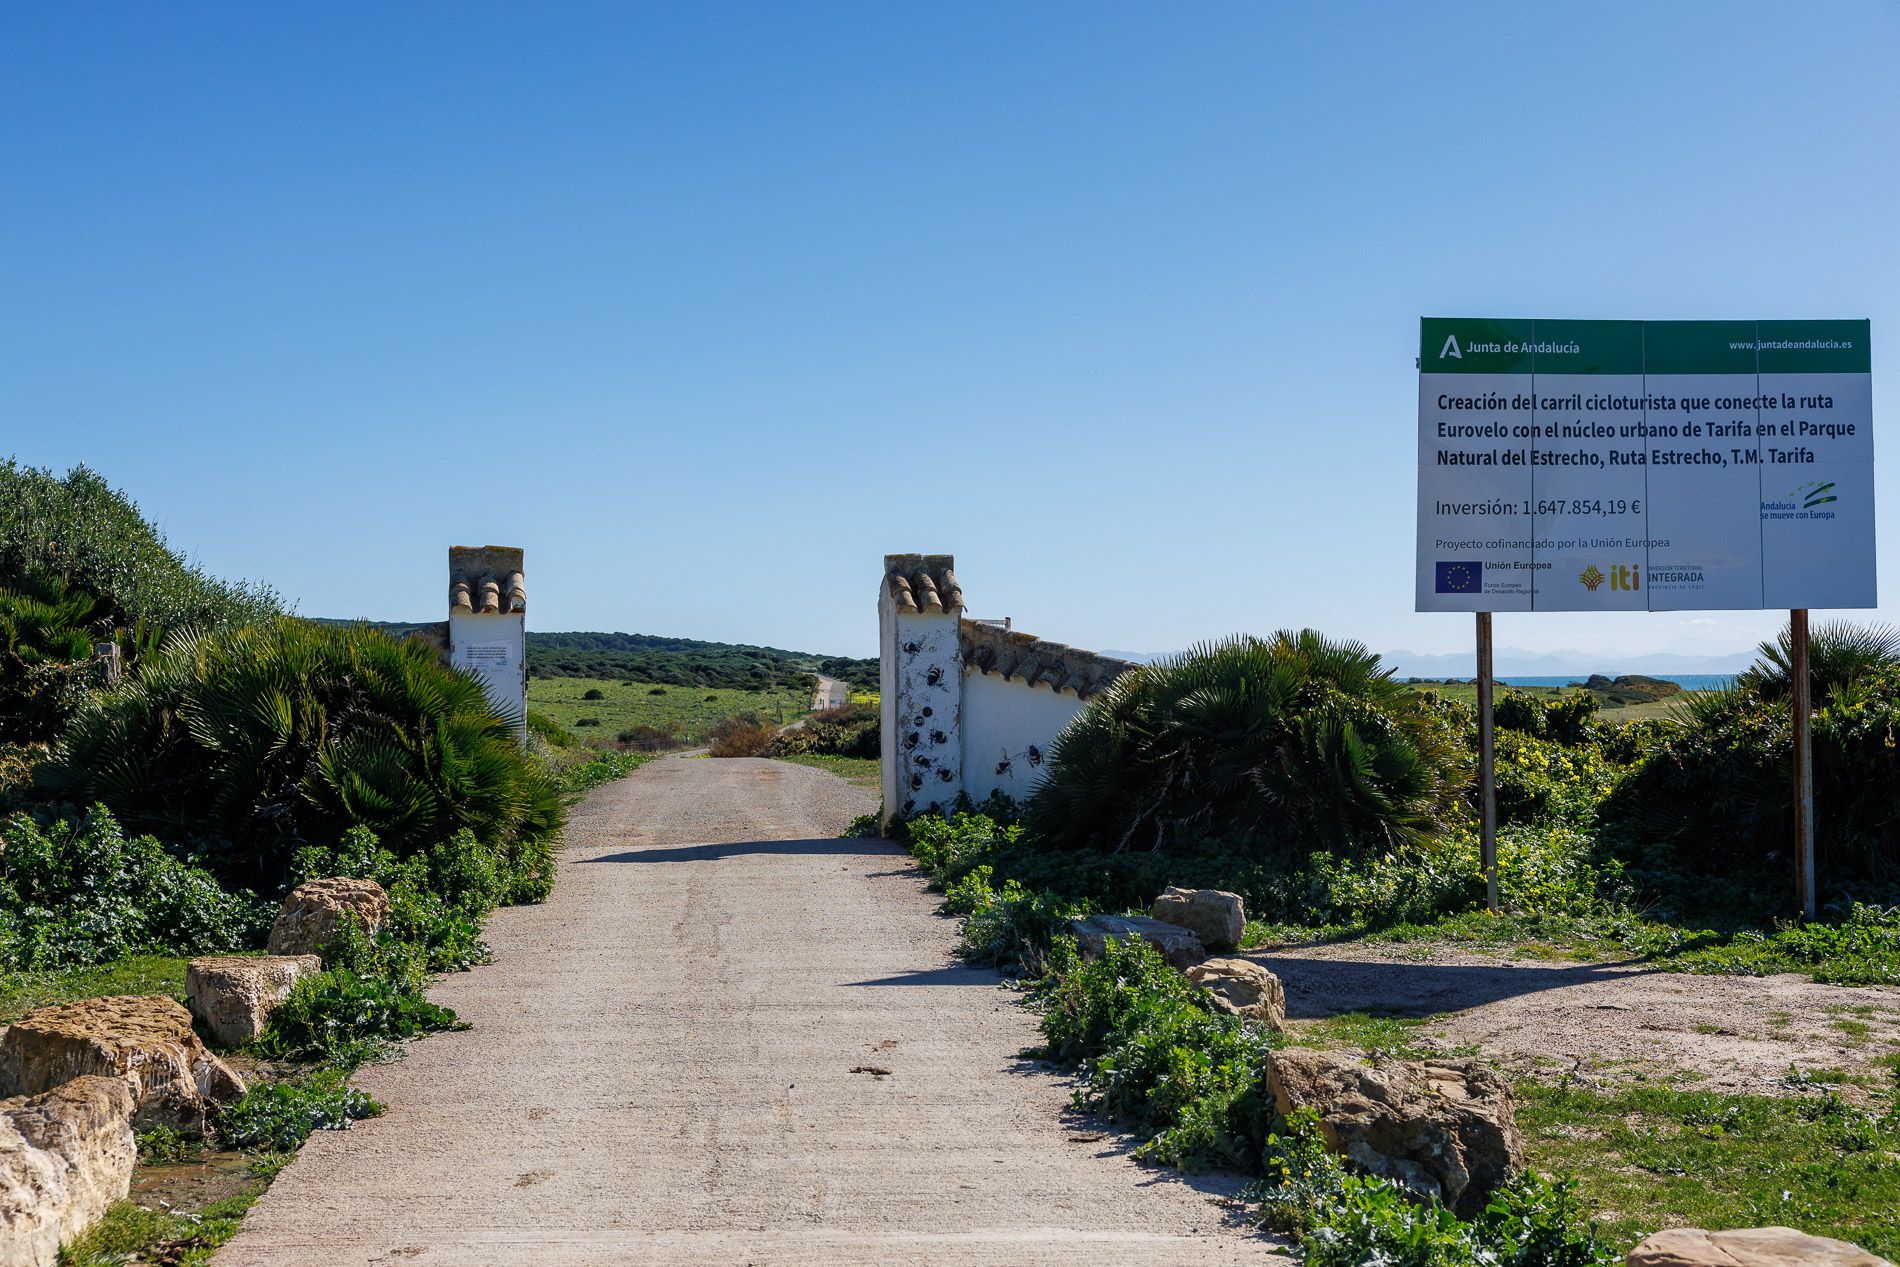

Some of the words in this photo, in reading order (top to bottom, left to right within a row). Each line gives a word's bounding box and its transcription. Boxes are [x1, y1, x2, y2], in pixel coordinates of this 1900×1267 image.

[1467, 342, 1500, 353] Junta
[1504, 342, 1518, 353] de
[1521, 341, 1580, 354] Andalucía
[1730, 340, 1852, 350] www.juntadeandalucia.es
[1438, 392, 1507, 410] Creación
[1512, 394, 1537, 410] del
[1541, 394, 1581, 410] carril
[1585, 394, 1676, 411] cicloturista
[1681, 397, 1710, 413] que
[1715, 396, 1777, 409] conecte
[1782, 393, 1795, 409] la
[1801, 395, 1833, 408] ruta
[1438, 422, 1508, 438] Eurovelo
[1513, 425, 1541, 438] con
[1545, 422, 1559, 438] el
[1563, 419, 1615, 438] núcleo
[1620, 422, 1678, 438] urbano
[1683, 422, 1701, 437] de
[1706, 421, 1751, 437] Tarifa
[1756, 425, 1776, 436] en
[1781, 421, 1795, 436] el
[1800, 421, 1855, 439] Parque
[1438, 450, 1497, 465] Natural
[1502, 450, 1525, 465] del
[1531, 450, 1605, 469] Estrecho,
[1609, 451, 1647, 465] Ruta
[1652, 449, 1727, 468] Estrecho,
[1731, 449, 1763, 464] T.M.
[1768, 447, 1814, 463] Tarifa
[1436, 498, 1518, 515] Inversión:
[1523, 500, 1626, 518] 1.647.854,19
[1631, 500, 1640, 514] €
[1761, 502, 1795, 510] Andalucía
[1810, 511, 1835, 520] Europa
[1436, 540, 1483, 551] Proyecto
[1486, 539, 1555, 549] cofinanciado
[1558, 542, 1575, 551] por
[1579, 539, 1587, 548] la
[1591, 537, 1621, 548] Unión
[1625, 538, 1670, 548] Europea
[1514, 562, 1552, 570] Europea
[1611, 564, 1639, 591] iti
[1649, 573, 1704, 582] INTEGRADA
